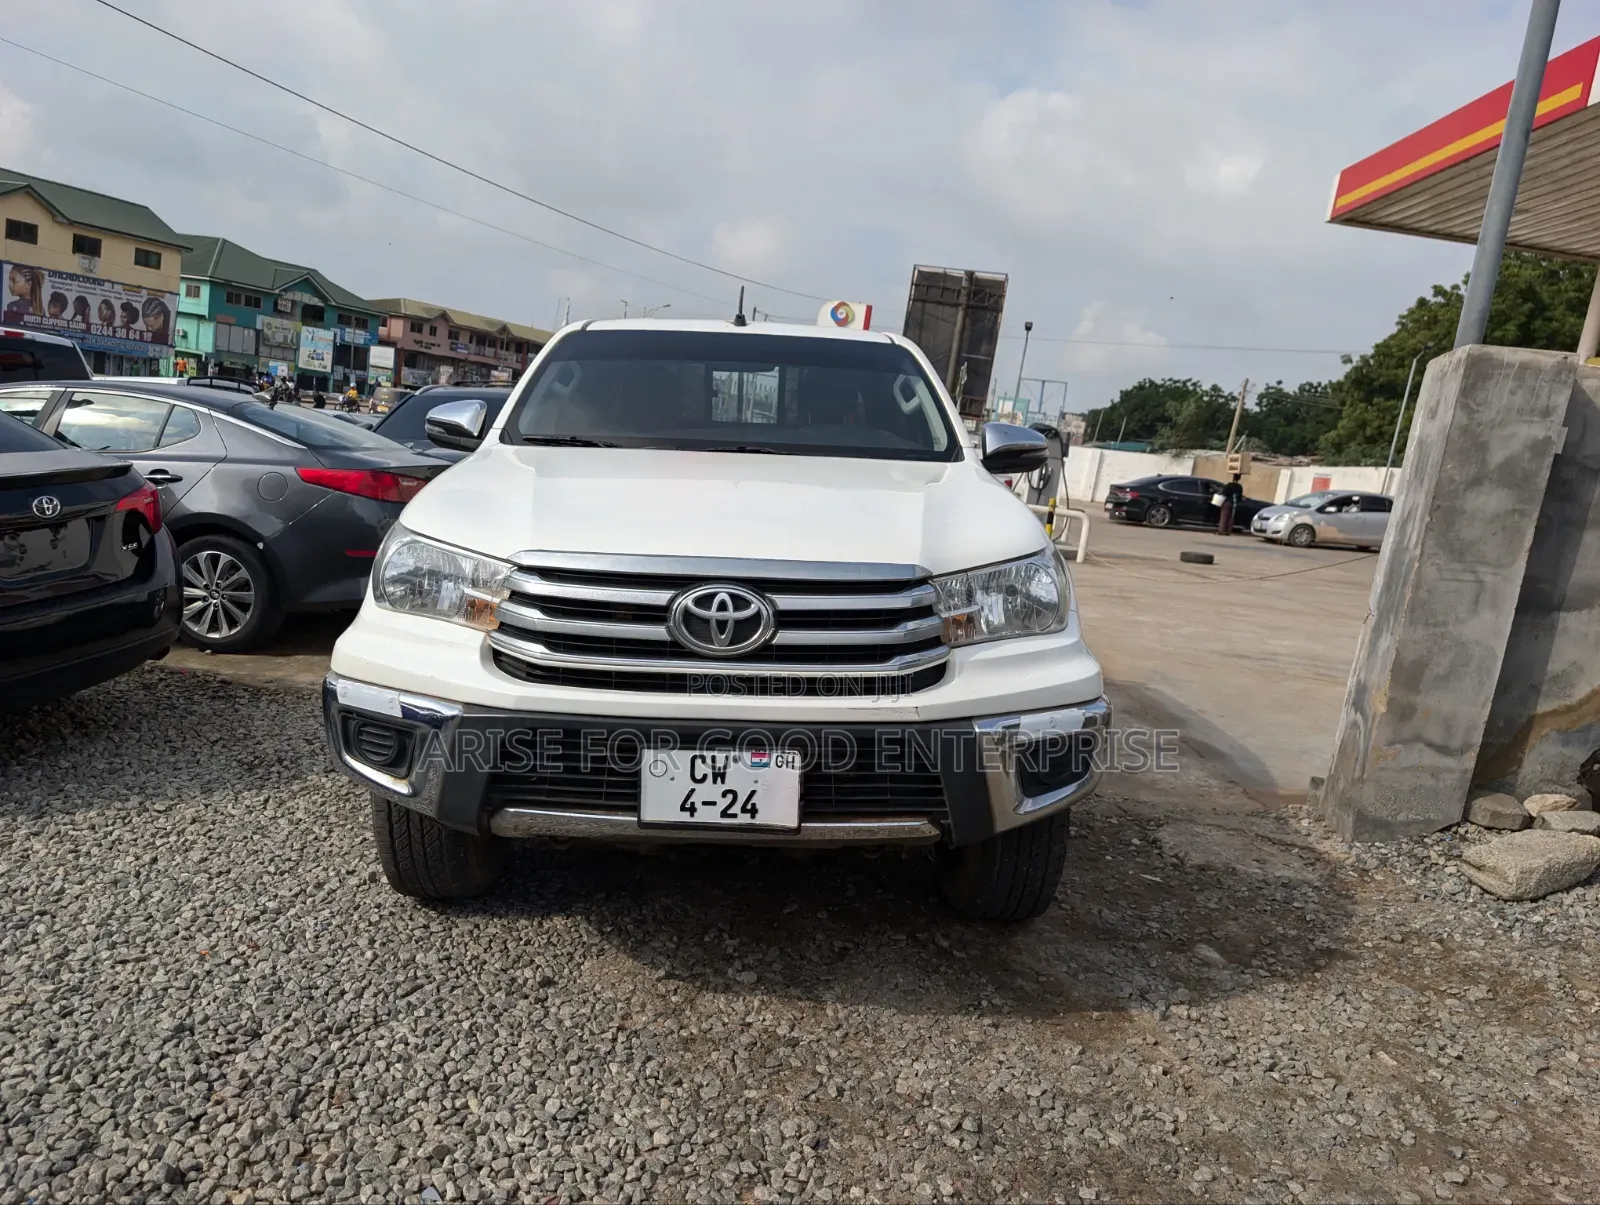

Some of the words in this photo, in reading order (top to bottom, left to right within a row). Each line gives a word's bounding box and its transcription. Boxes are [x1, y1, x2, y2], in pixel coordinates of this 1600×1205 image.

[91, 323, 113, 336] 0244
[115, 327, 127, 339] 30
[129, 329, 140, 340] 64
[689, 754, 729, 785] CW
[775, 755, 795, 770] GH
[679, 787, 759, 820] 4-24
